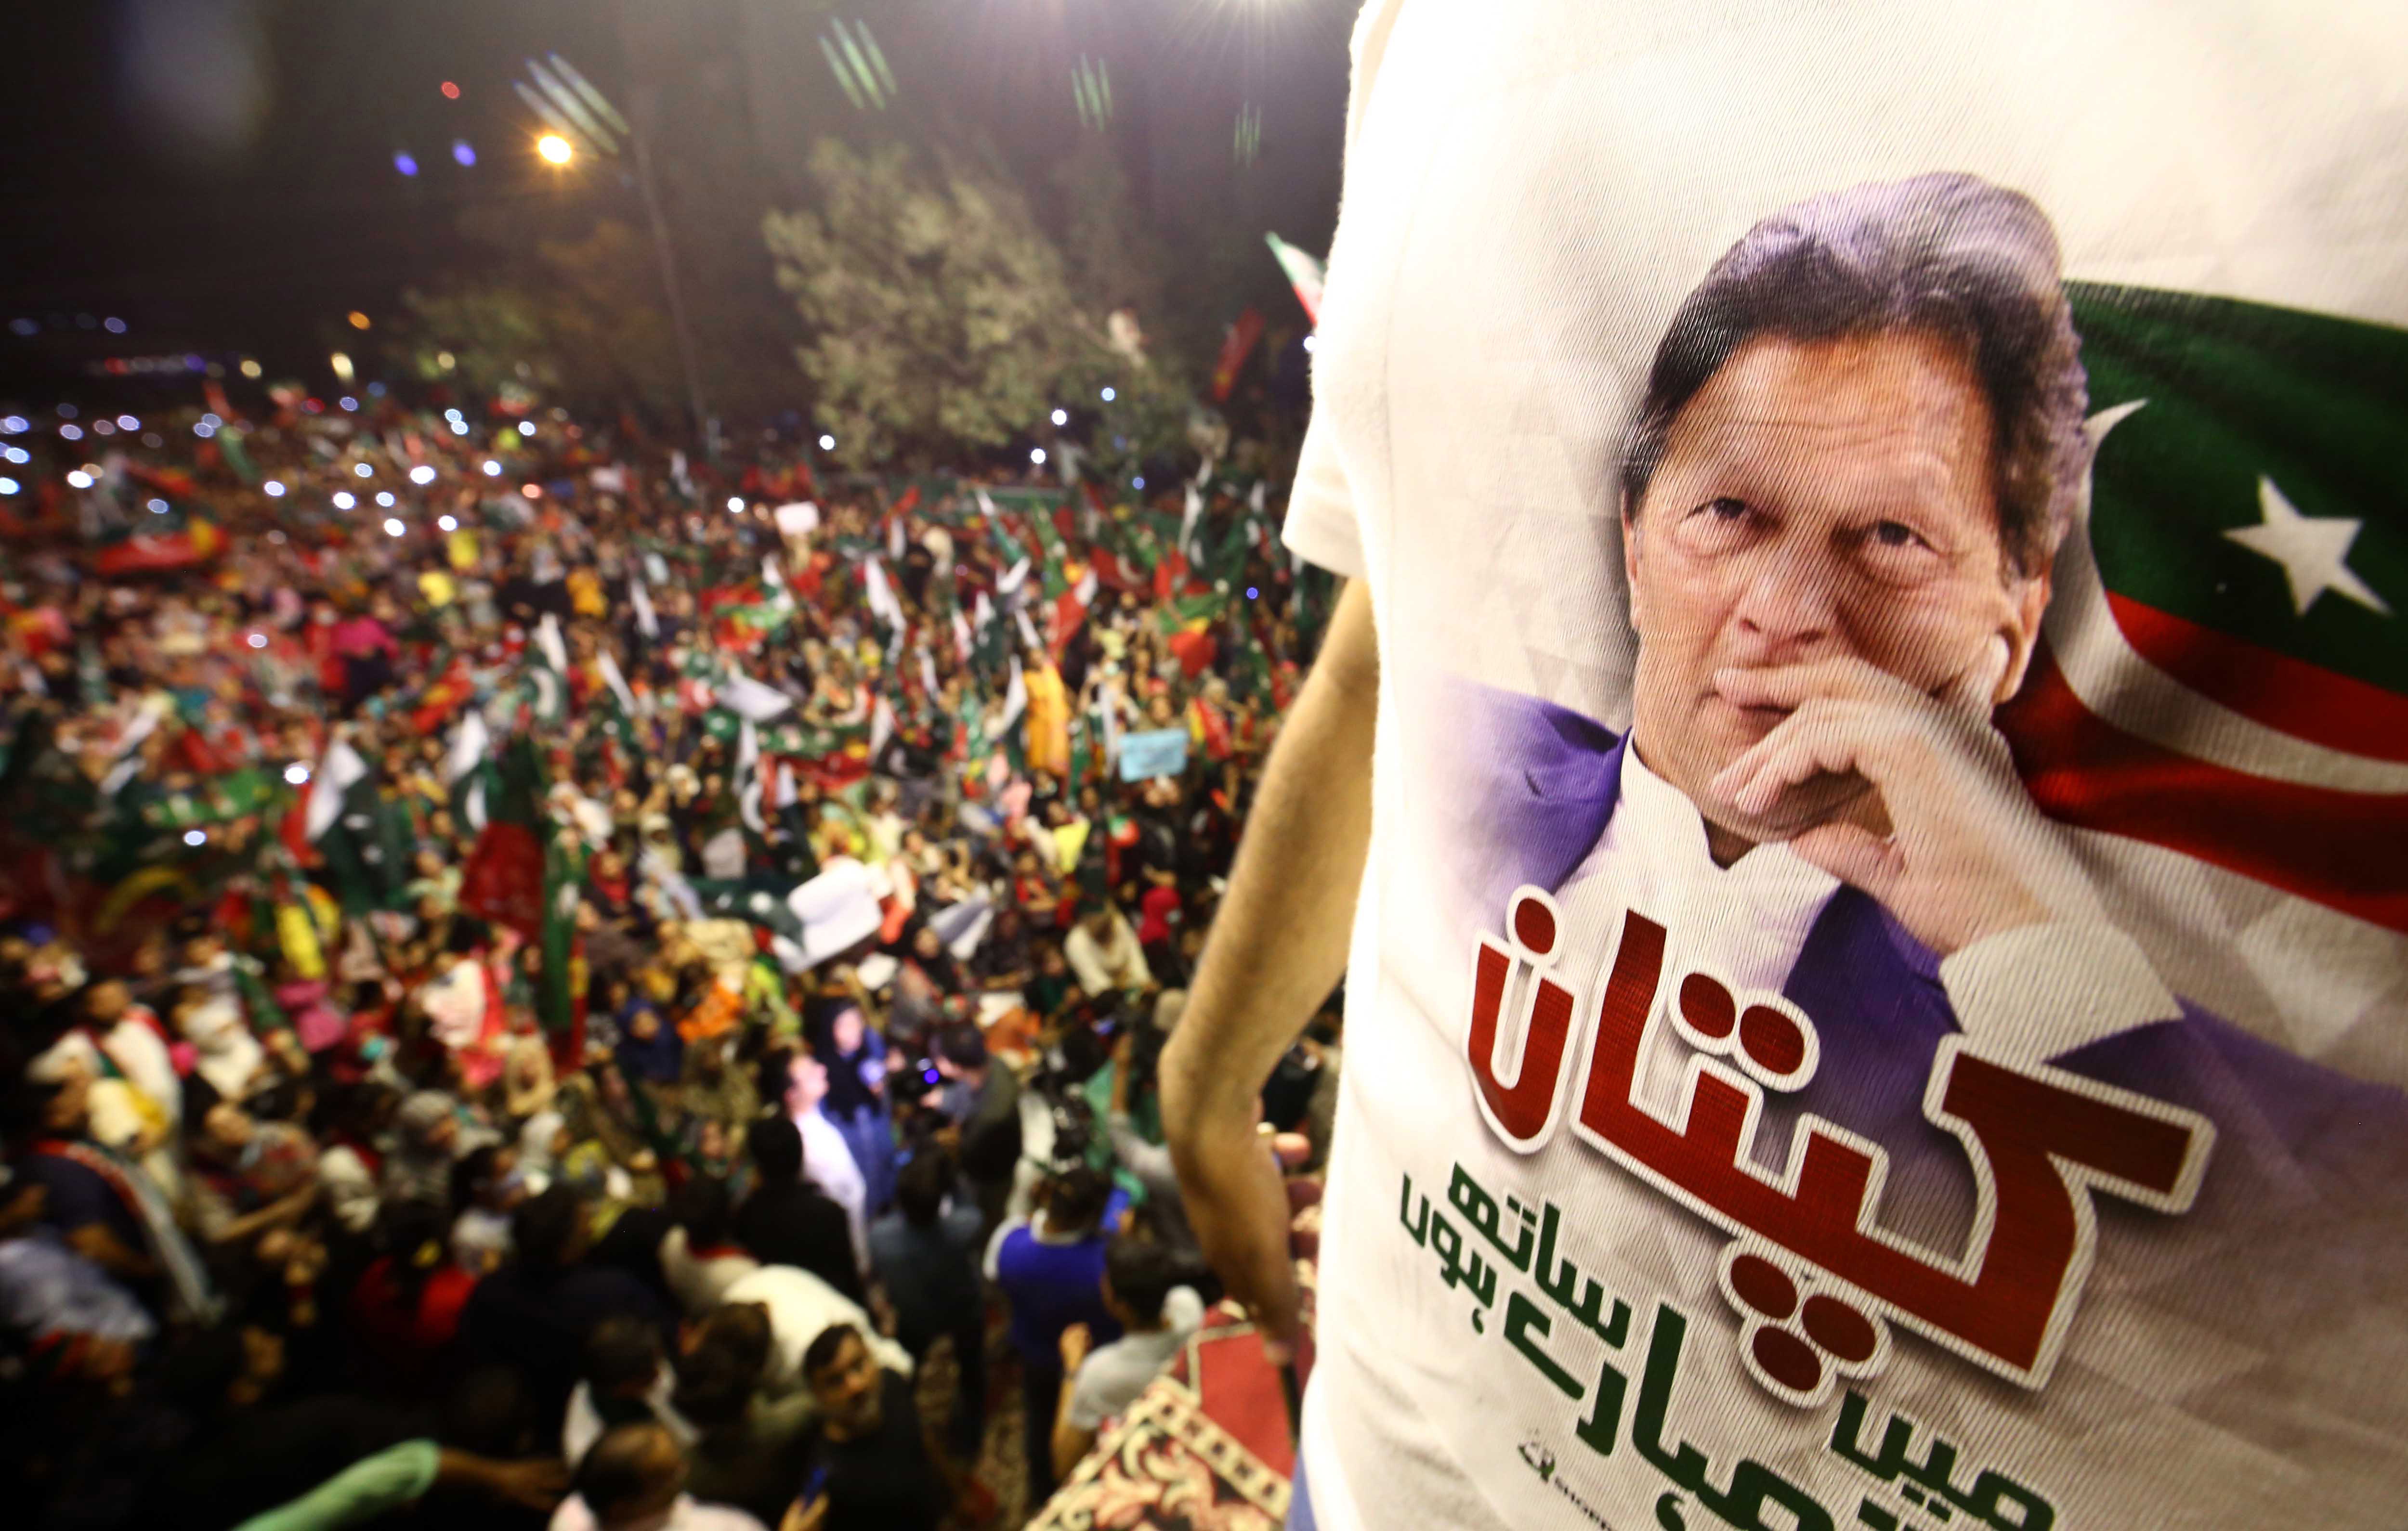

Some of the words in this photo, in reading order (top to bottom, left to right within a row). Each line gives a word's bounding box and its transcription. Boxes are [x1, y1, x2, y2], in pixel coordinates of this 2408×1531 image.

[1467, 889, 2206, 1402] کپتان
[1400, 1172, 1497, 1335] ہوں
[1448, 1161, 1632, 1349] ساتھ
[1503, 1290, 1933, 1531] مہارے
